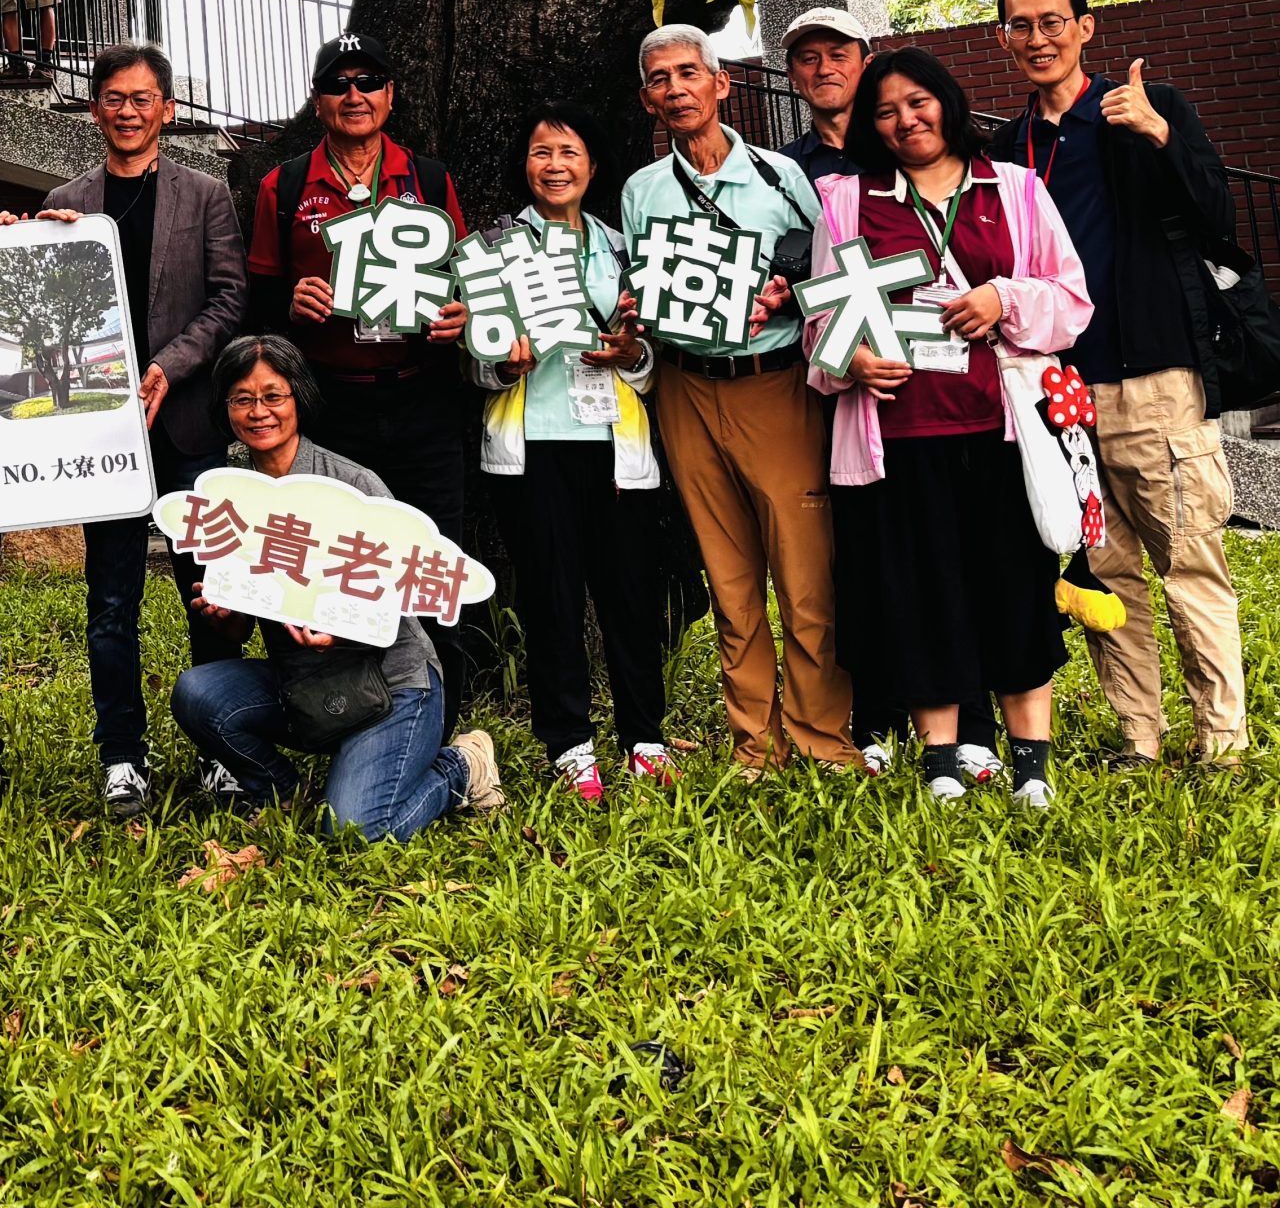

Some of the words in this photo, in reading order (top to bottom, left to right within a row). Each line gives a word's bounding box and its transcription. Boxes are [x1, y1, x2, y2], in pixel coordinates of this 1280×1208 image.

[297, 196, 329, 212] UNITED
[2, 463, 45, 485] NO.
[50, 455, 95, 482] 大寮
[101, 452, 139, 474] 091
[176, 494, 469, 622] 珍貴老樹
